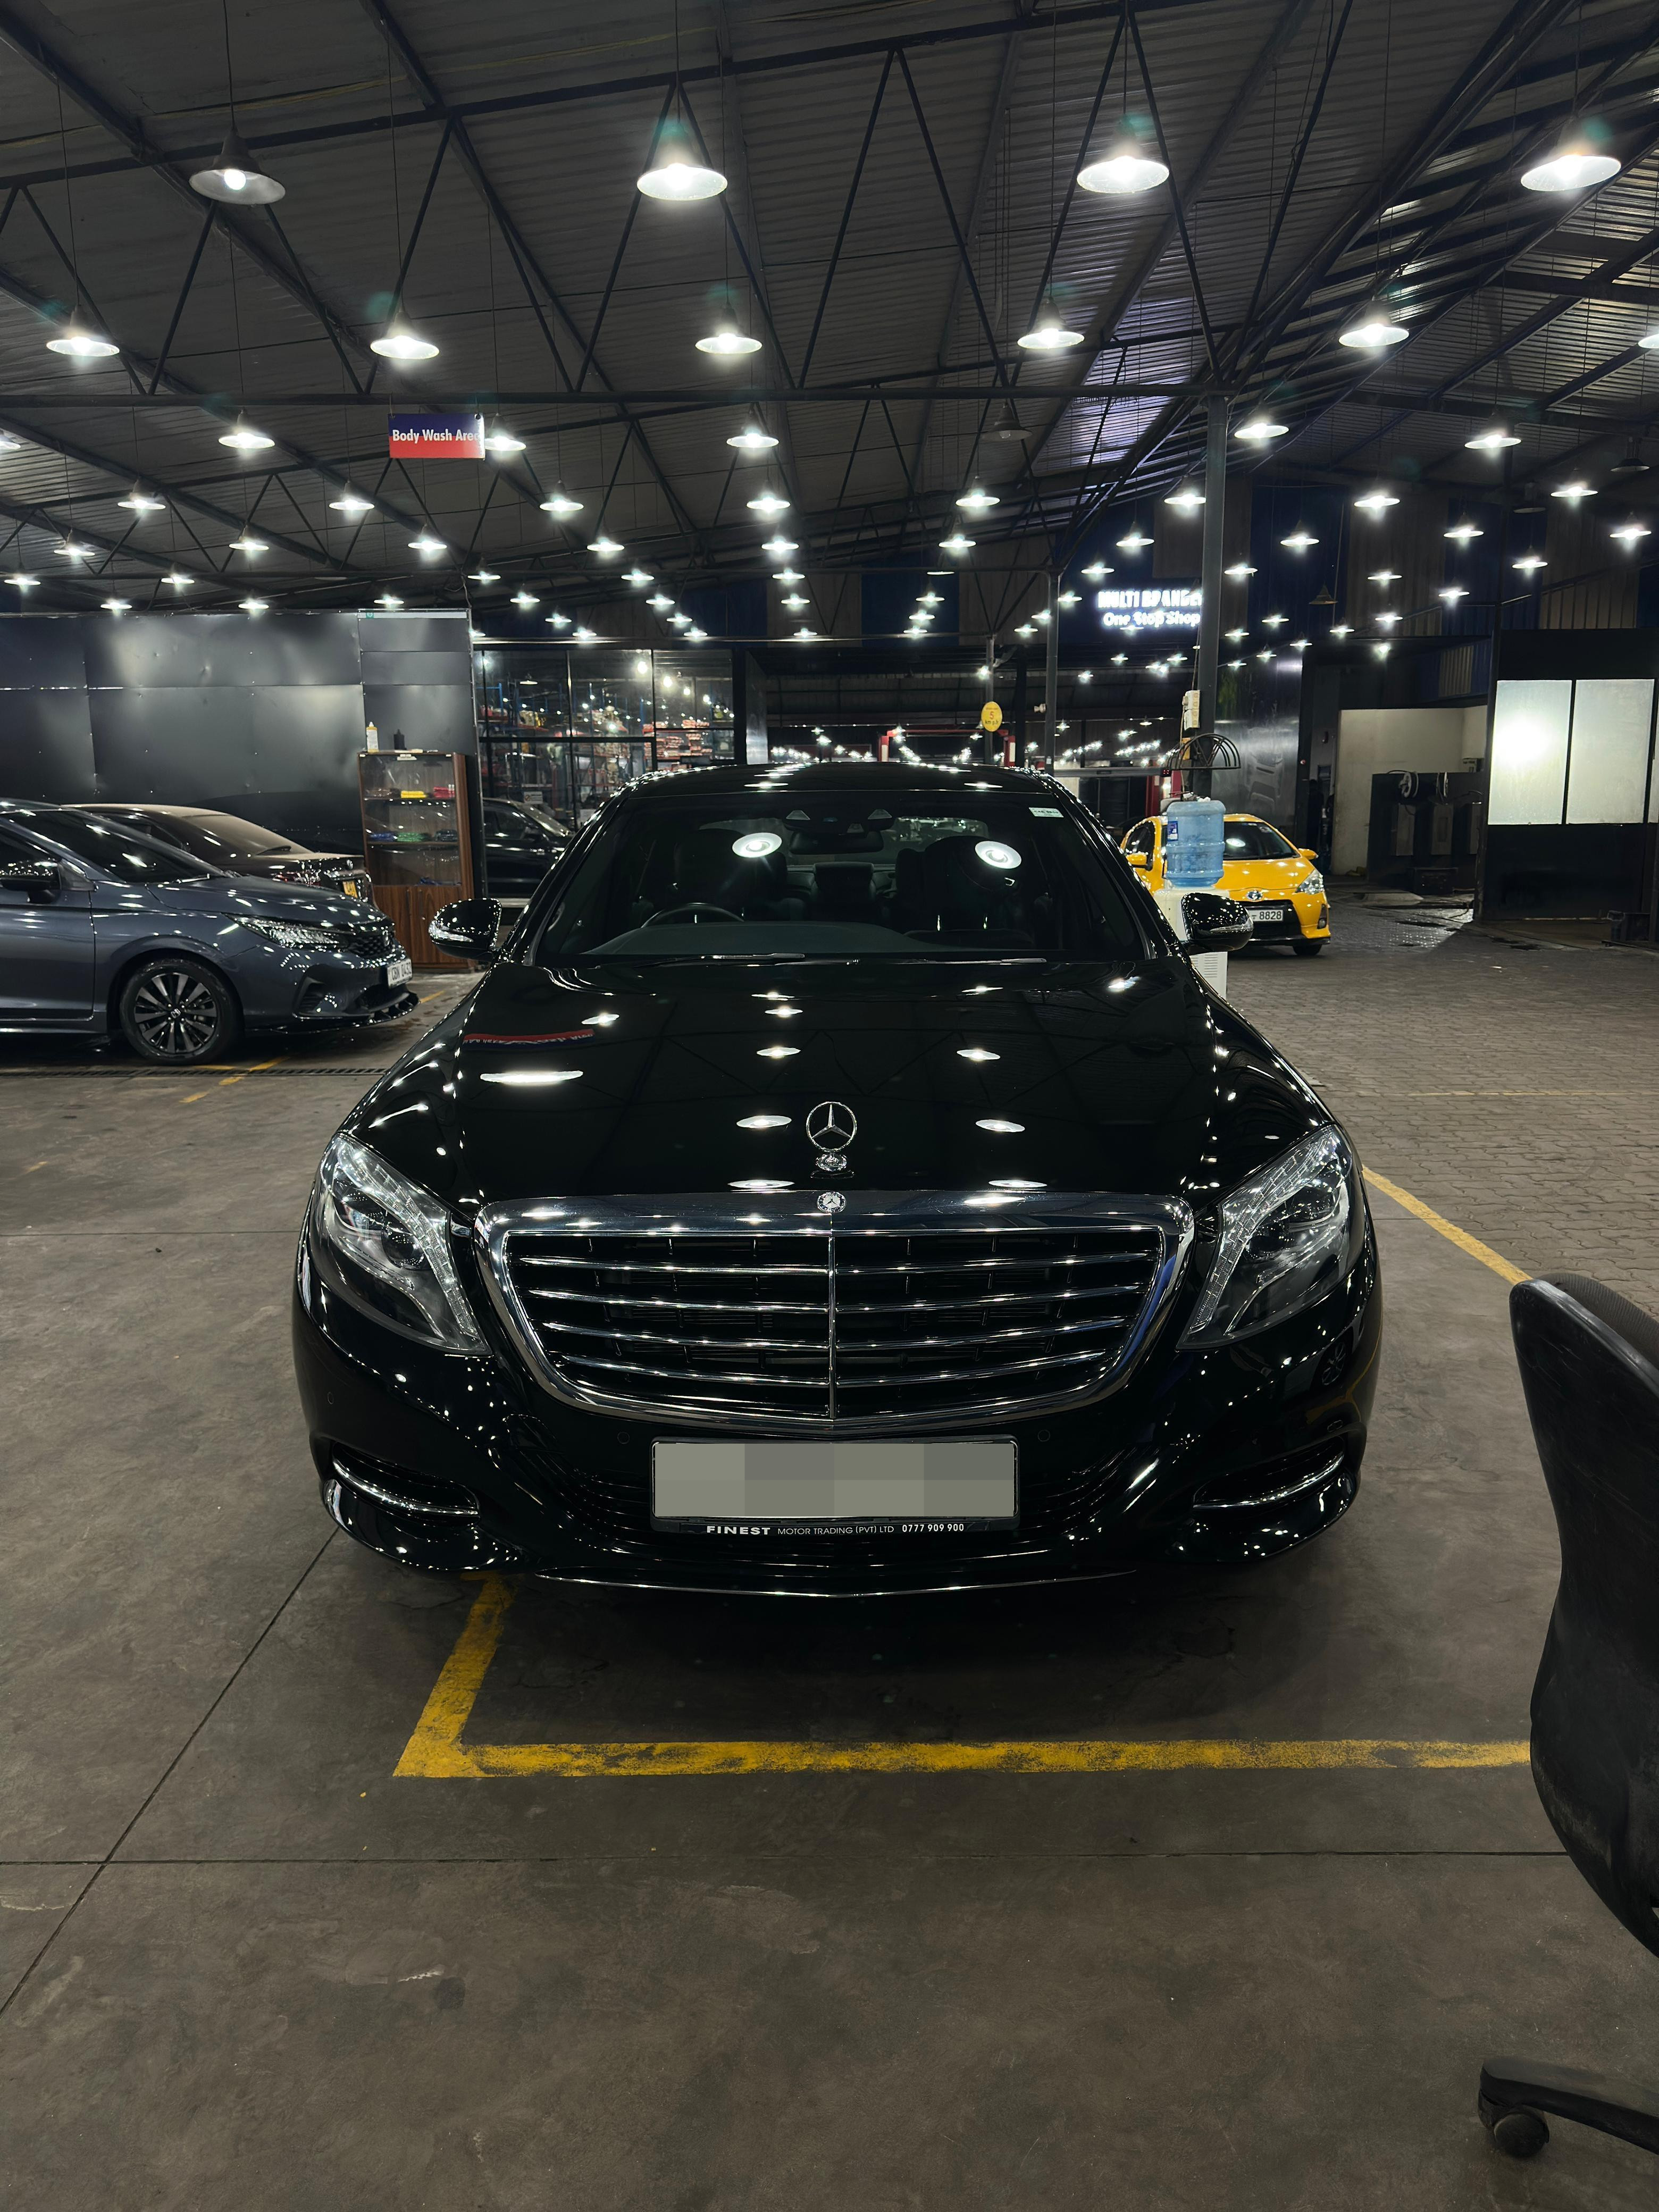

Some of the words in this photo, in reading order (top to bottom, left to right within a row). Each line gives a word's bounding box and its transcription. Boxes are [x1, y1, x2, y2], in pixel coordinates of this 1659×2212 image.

[392, 429, 420, 443] Body
[422, 429, 452, 441] Wash
[1098, 591, 1141, 608] MULTI
[1103, 613, 1131, 627] One
[1134, 611, 1166, 629] Stop
[1167, 611, 1201, 627] Shop
[990, 711, 994, 719] 5
[1259, 911, 1281, 920] 8828
[707, 1526, 770, 1535] FINEST
[814, 1527, 853, 1535] TRADING
[902, 1524, 925, 1532] 0777
[927, 1523, 944, 1532] 909
[947, 1523, 964, 1531] 900
